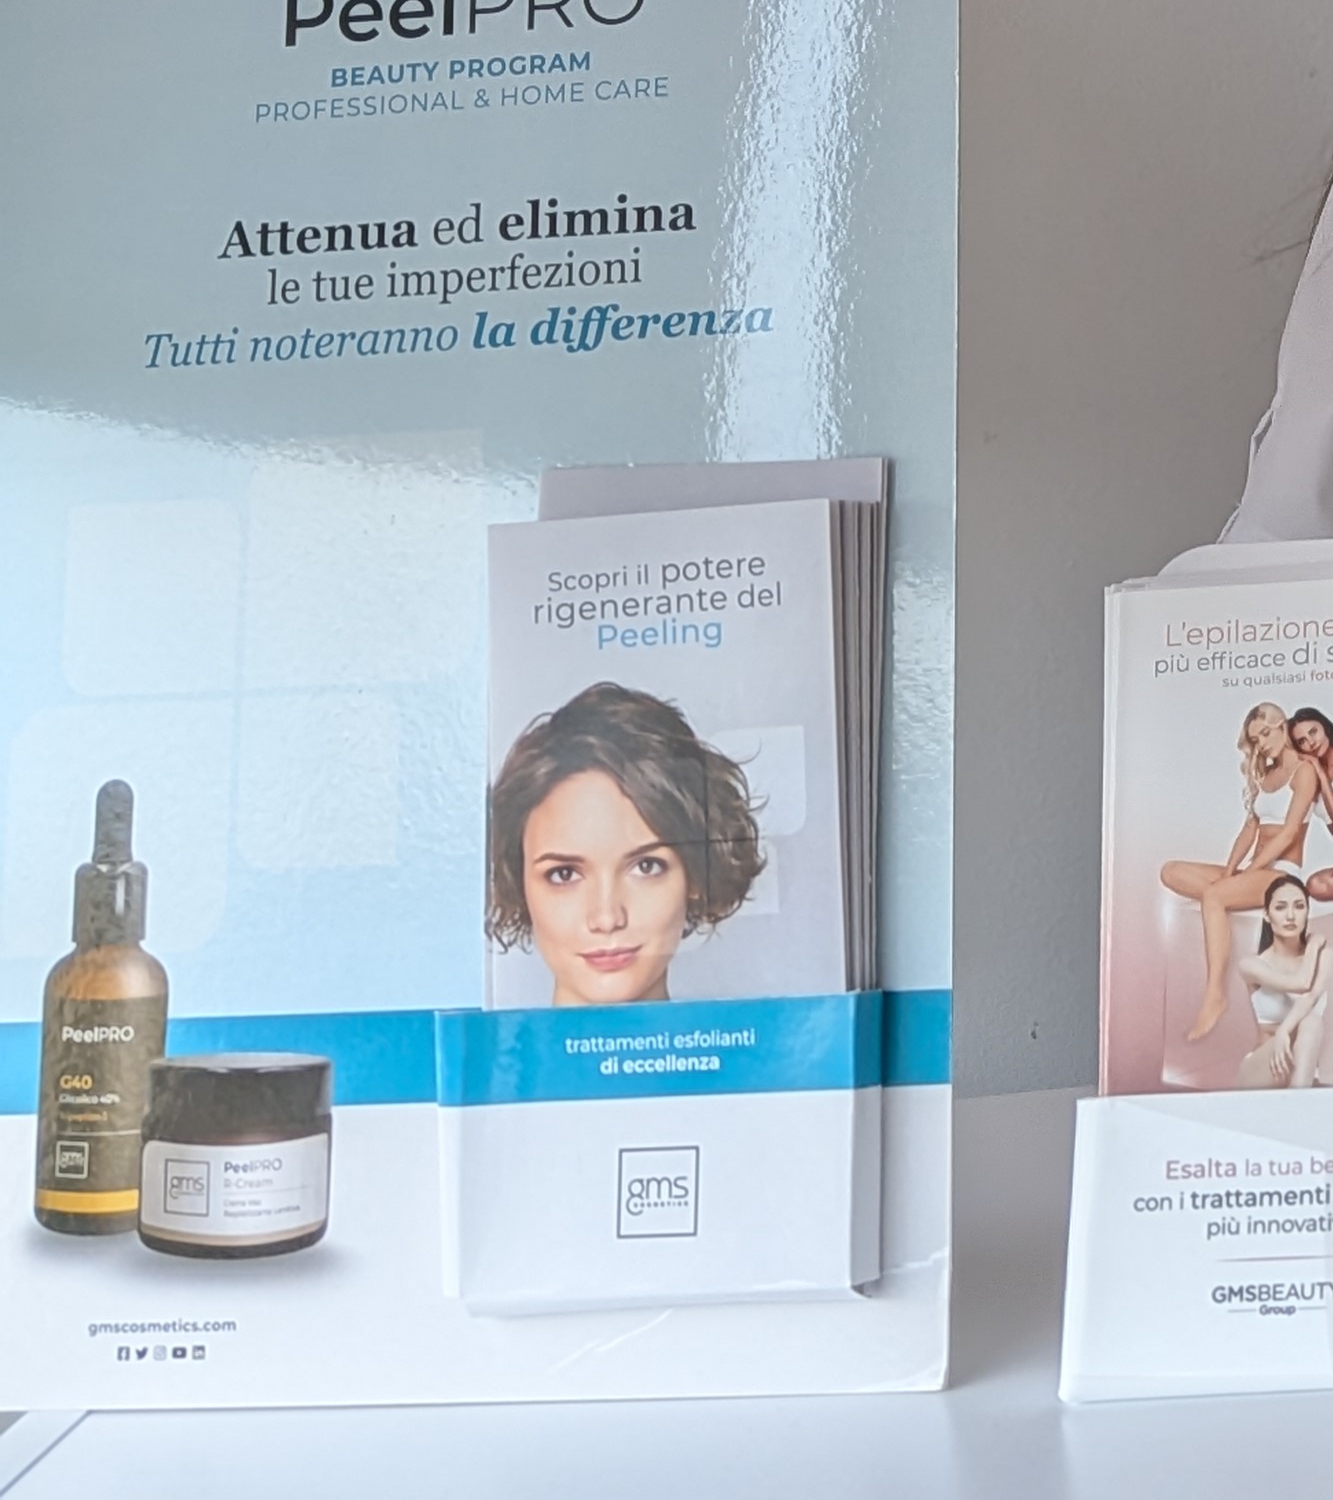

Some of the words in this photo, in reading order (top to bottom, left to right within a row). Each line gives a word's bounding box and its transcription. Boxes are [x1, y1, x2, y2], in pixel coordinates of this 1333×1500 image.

[331, 62, 439, 88] BEAUTY
[449, 51, 591, 80] PROGRAM
[255, 90, 464, 124] PROFESSIONAL
[474, 89, 490, 108] &
[501, 82, 585, 107] HOME
[594, 76, 669, 100] CARE
[217, 219, 418, 260] Attenua
[432, 203, 485, 245] ed
[498, 194, 697, 241] elimina
[267, 267, 301, 306] le
[313, 266, 374, 302] tue
[386, 247, 643, 305] imperfezioni
[144, 328, 237, 369] Tutti
[249, 319, 459, 362] noteranno
[472, 311, 516, 351] la
[529, 303, 774, 354] differenza
[548, 565, 628, 593] Scopri
[636, 564, 649, 585] il
[661, 555, 766, 590] potere
[534, 588, 728, 629] rigenerante
[737, 581, 782, 609] del
[598, 617, 722, 650] Peeling
[1154, 653, 1190, 678] più
[1197, 650, 1286, 672] efficace
[1292, 642, 1319, 666] di
[1222, 677, 1239, 688] su
[1243, 670, 1307, 688] qualsiasi
[62, 1026, 134, 1043] PeelPRO
[565, 1032, 670, 1055] trattamenti
[673, 1028, 755, 1048] esfolianti
[600, 1057, 618, 1075] di
[622, 1054, 721, 1074] eccellenza
[60, 1074, 93, 1089] G40
[224, 1158, 283, 1173] PeelPRO
[1165, 1158, 1237, 1180] Esalta
[1245, 1158, 1262, 1177] la
[1268, 1158, 1303, 1176] tua
[625, 1176, 689, 1216] gms
[1133, 1195, 1172, 1212] con
[1179, 1192, 1185, 1210] i
[1190, 1183, 1331, 1210] trattamenti
[1206, 1217, 1241, 1240] più
[1259, 1304, 1296, 1316] Group
[88, 1319, 236, 1337] gmscosmetics.com
